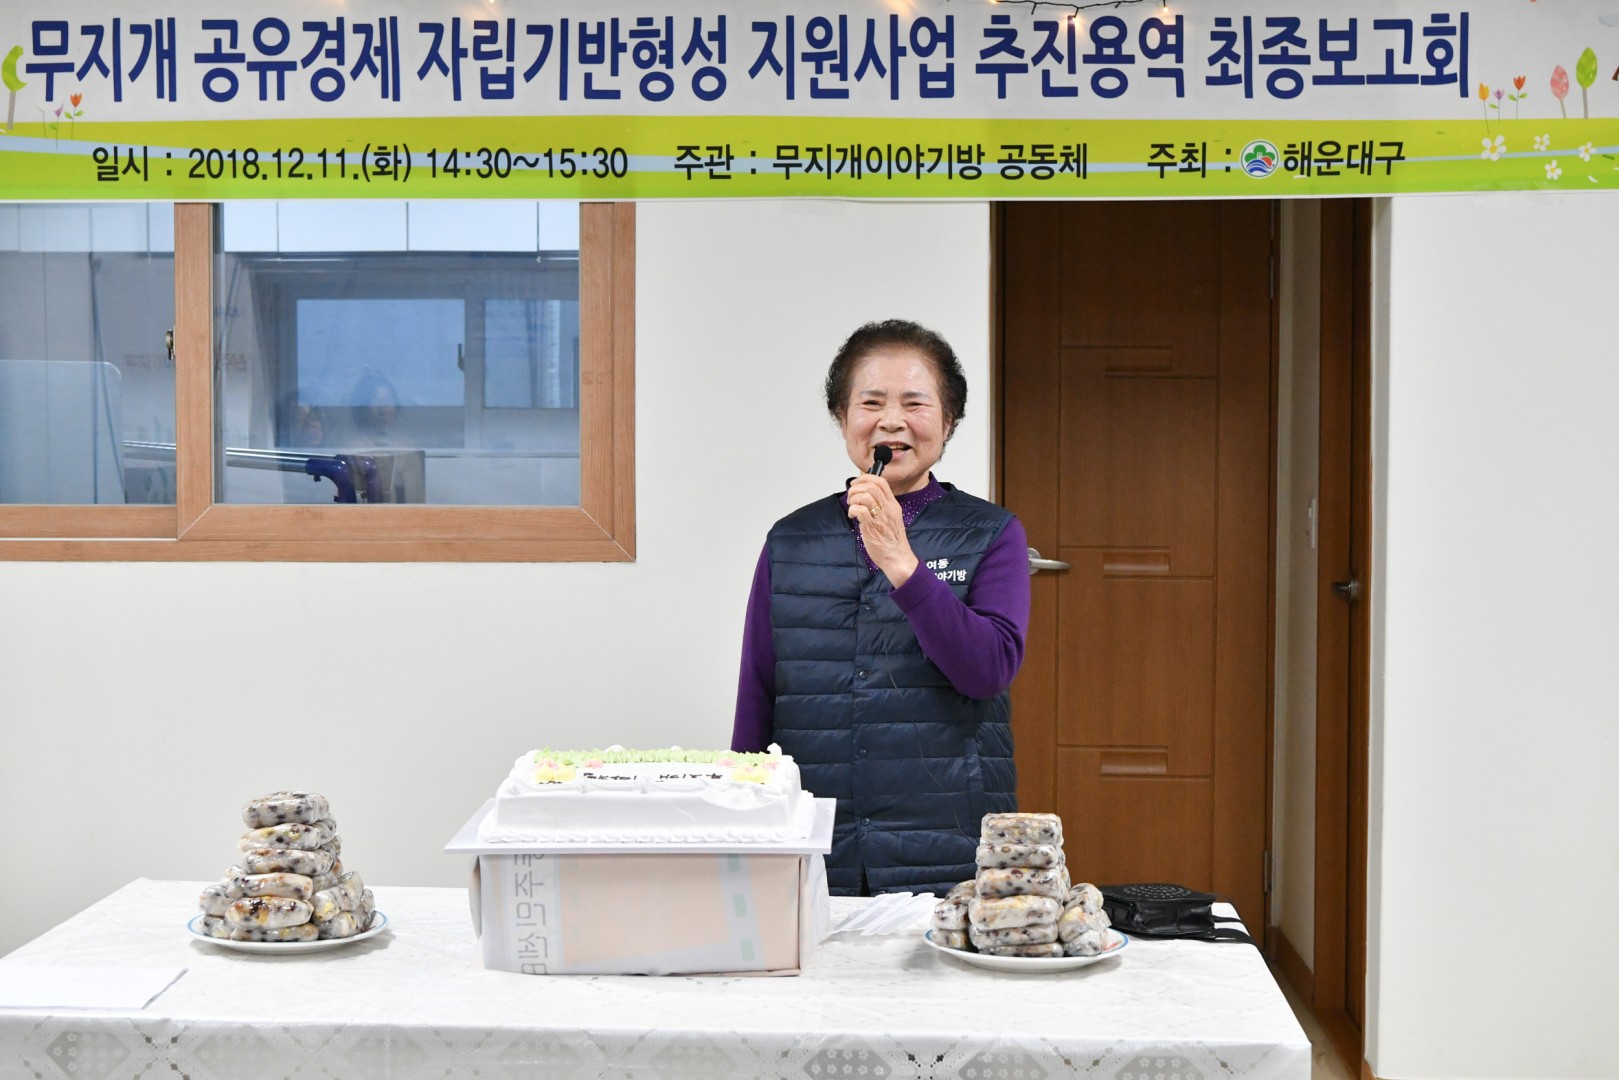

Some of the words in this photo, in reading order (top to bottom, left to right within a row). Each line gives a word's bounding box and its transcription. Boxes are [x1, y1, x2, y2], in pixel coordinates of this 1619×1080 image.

[26, 17, 177, 103] 무지개
[195, 16, 401, 103] 공유경제
[417, 15, 728, 102] 자립기반형성
[748, 15, 956, 101] 지원사업
[975, 15, 1186, 99] 추진용역
[1205, 11, 1470, 100] 최종보고회
[92, 145, 149, 182] 일시
[187, 143, 412, 183] 2018.12.11.(화)
[427, 146, 629, 180] 14:30~15:30
[673, 143, 735, 181] 주관
[772, 143, 985, 181] 무지개이야기방
[997, 142, 1089, 181] 공동체
[1147, 141, 1208, 179] 주최
[1283, 139, 1407, 178] 해운대구
[935, 569, 967, 582] 야기방
